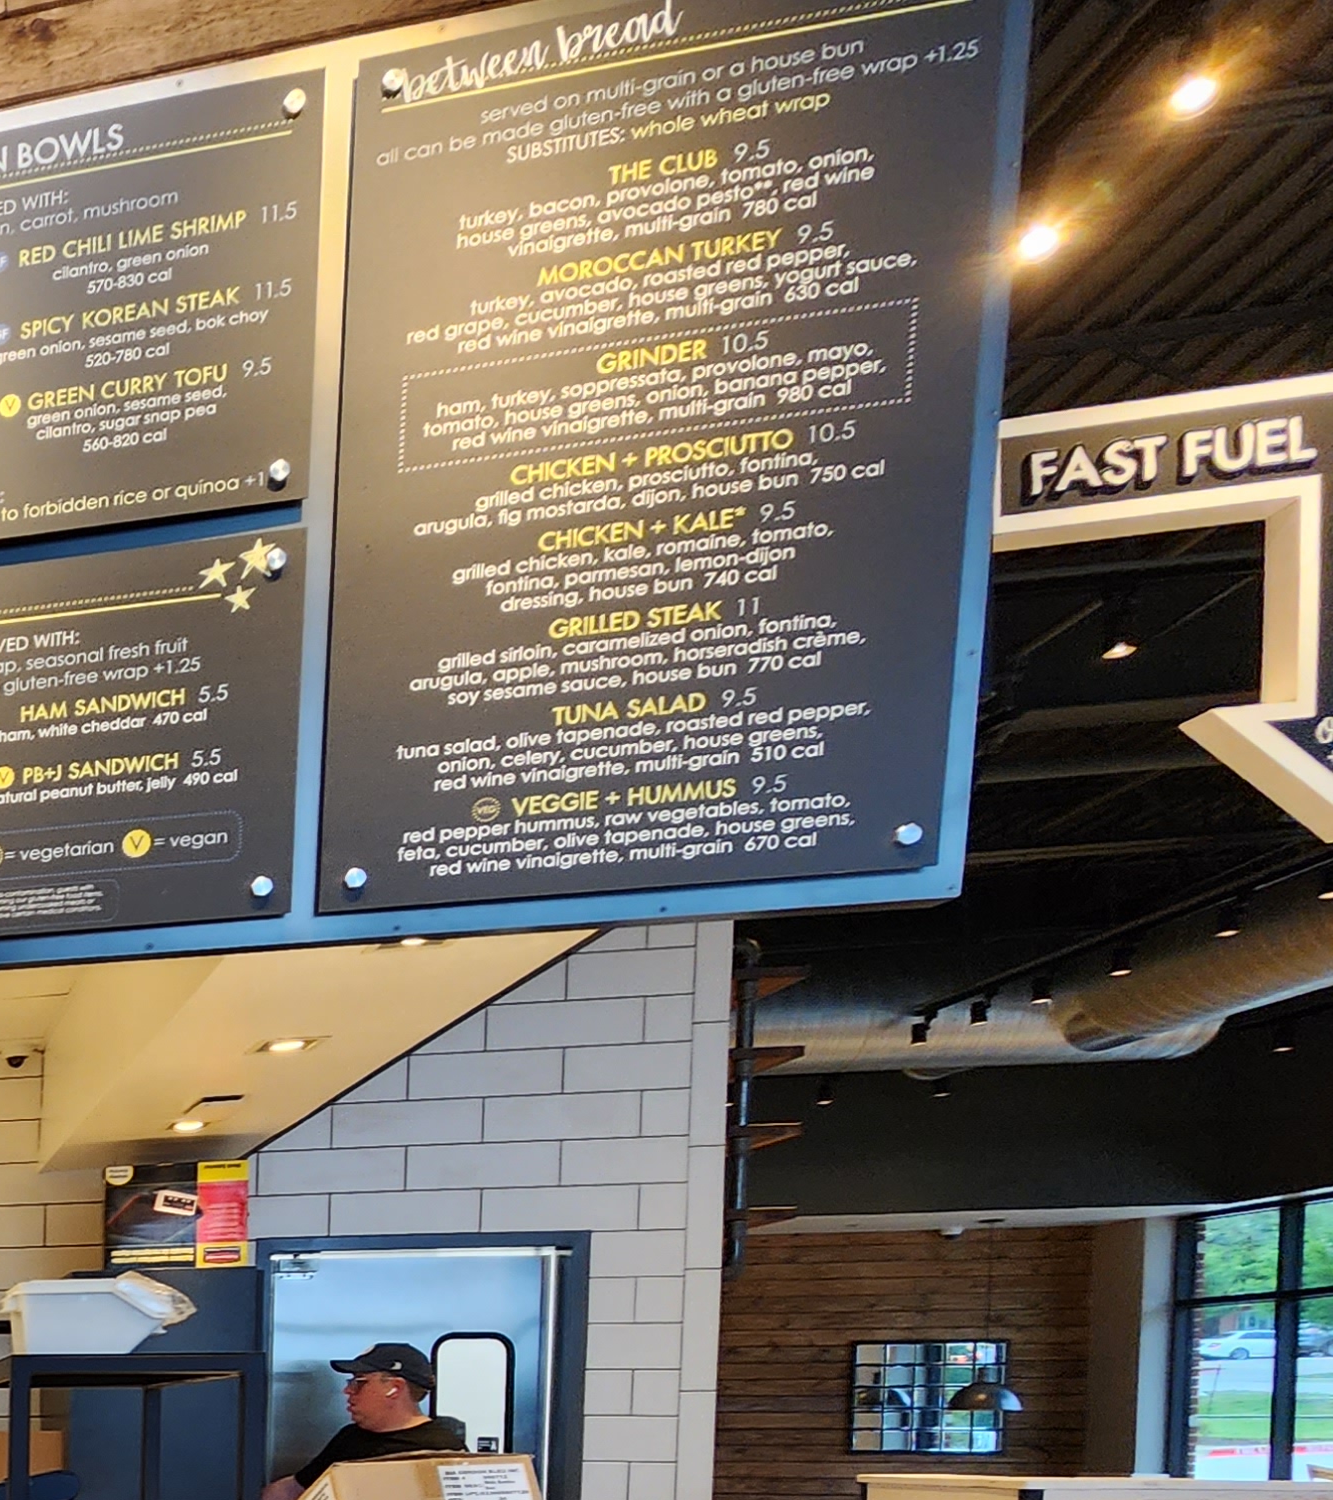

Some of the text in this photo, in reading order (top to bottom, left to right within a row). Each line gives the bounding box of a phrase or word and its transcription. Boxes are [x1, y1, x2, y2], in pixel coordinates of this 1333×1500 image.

[401, 0, 685, 103] between bread
[17, 123, 125, 169] BOWLS
[609, 139, 770, 184] THE CLUB 9.5
[22, 190, 68, 210] WITH:
[460, 148, 874, 229] turkey, bacon, provolone, tomato, onion,
[538, 222, 833, 286] MOROCCAN TURKEY 9.5
[21, 278, 291, 339] SPICY KOREAN STEAK 11.5
[85, 343, 169, 368] 520-780 cal
[511, 420, 856, 485] CHICKEN + PROSCIUTTO 10.5
[1029, 414, 1319, 497] FAST FUEL
[21, 684, 228, 722] HAM SANDWICH 5.5
[512, 774, 786, 816] VEGGIE + HUMMUS 9.5
[20, 841, 114, 862] vegetarian
[170, 832, 227, 849] vegan
